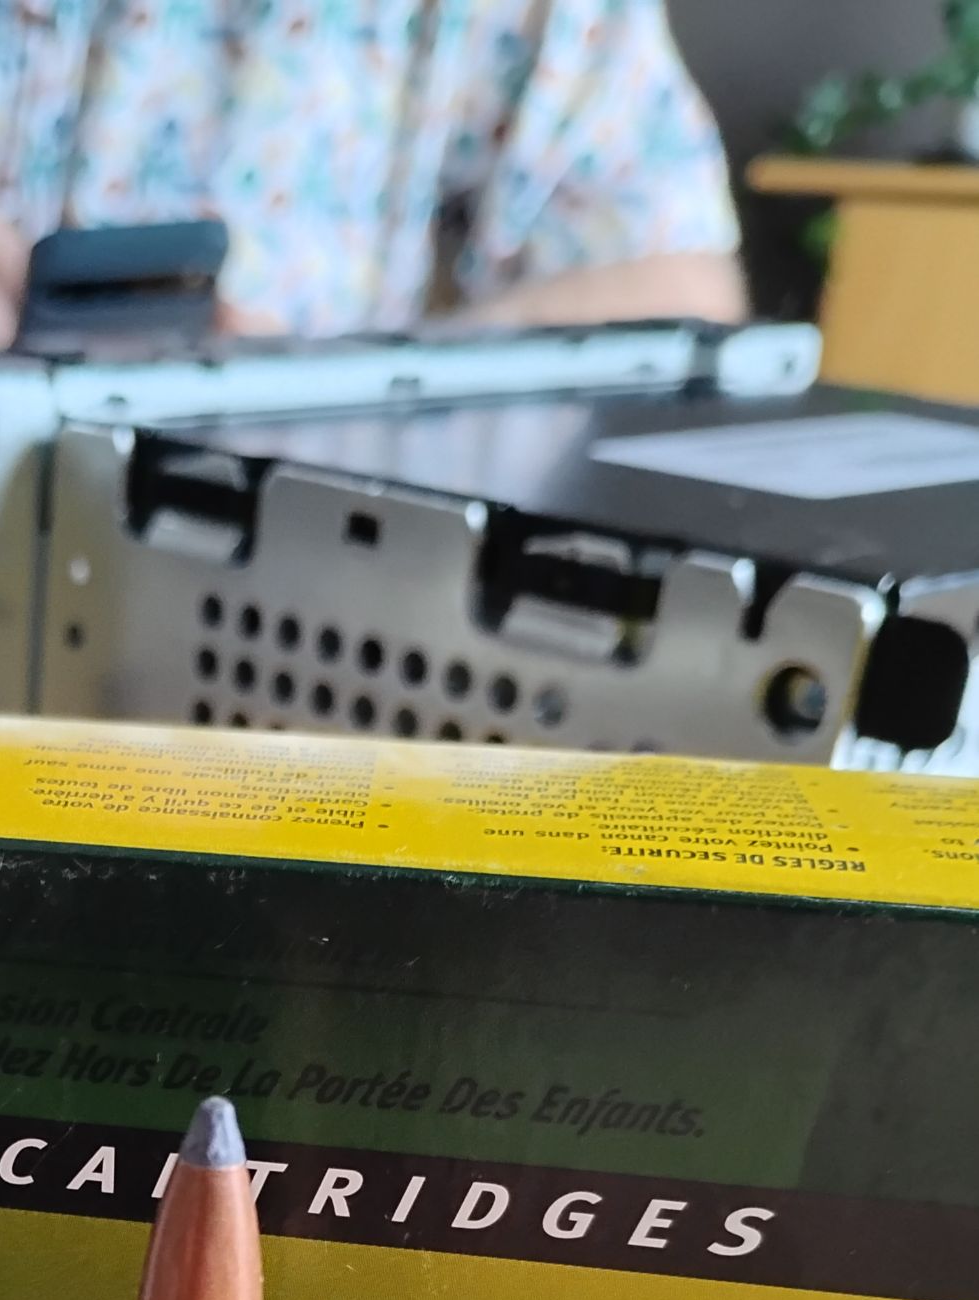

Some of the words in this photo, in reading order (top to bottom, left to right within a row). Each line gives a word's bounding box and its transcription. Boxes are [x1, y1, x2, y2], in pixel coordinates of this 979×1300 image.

[39, 797, 95, 811] votre
[101, 801, 129, 813] de
[136, 803, 283, 824] connaissance
[289, 814, 365, 830] Prenez
[482, 826, 525, 838] une
[533, 829, 590, 843] dans
[599, 831, 669, 843] canon
[677, 834, 737, 849] votre
[746, 838, 833, 854] Pointez
[599, 844, 727, 864] SECURITE:
[733, 852, 765, 866] DE
[770, 854, 866, 872] REGLES
[91, 994, 269, 1044] Centrale
[58, 1042, 155, 1089] Hors
[163, 1053, 221, 1093] De
[230, 1058, 282, 1099] La
[287, 1063, 431, 1113] Portée
[439, 1077, 519, 1122] Des
[530, 1085, 706, 1139] Enfants.
